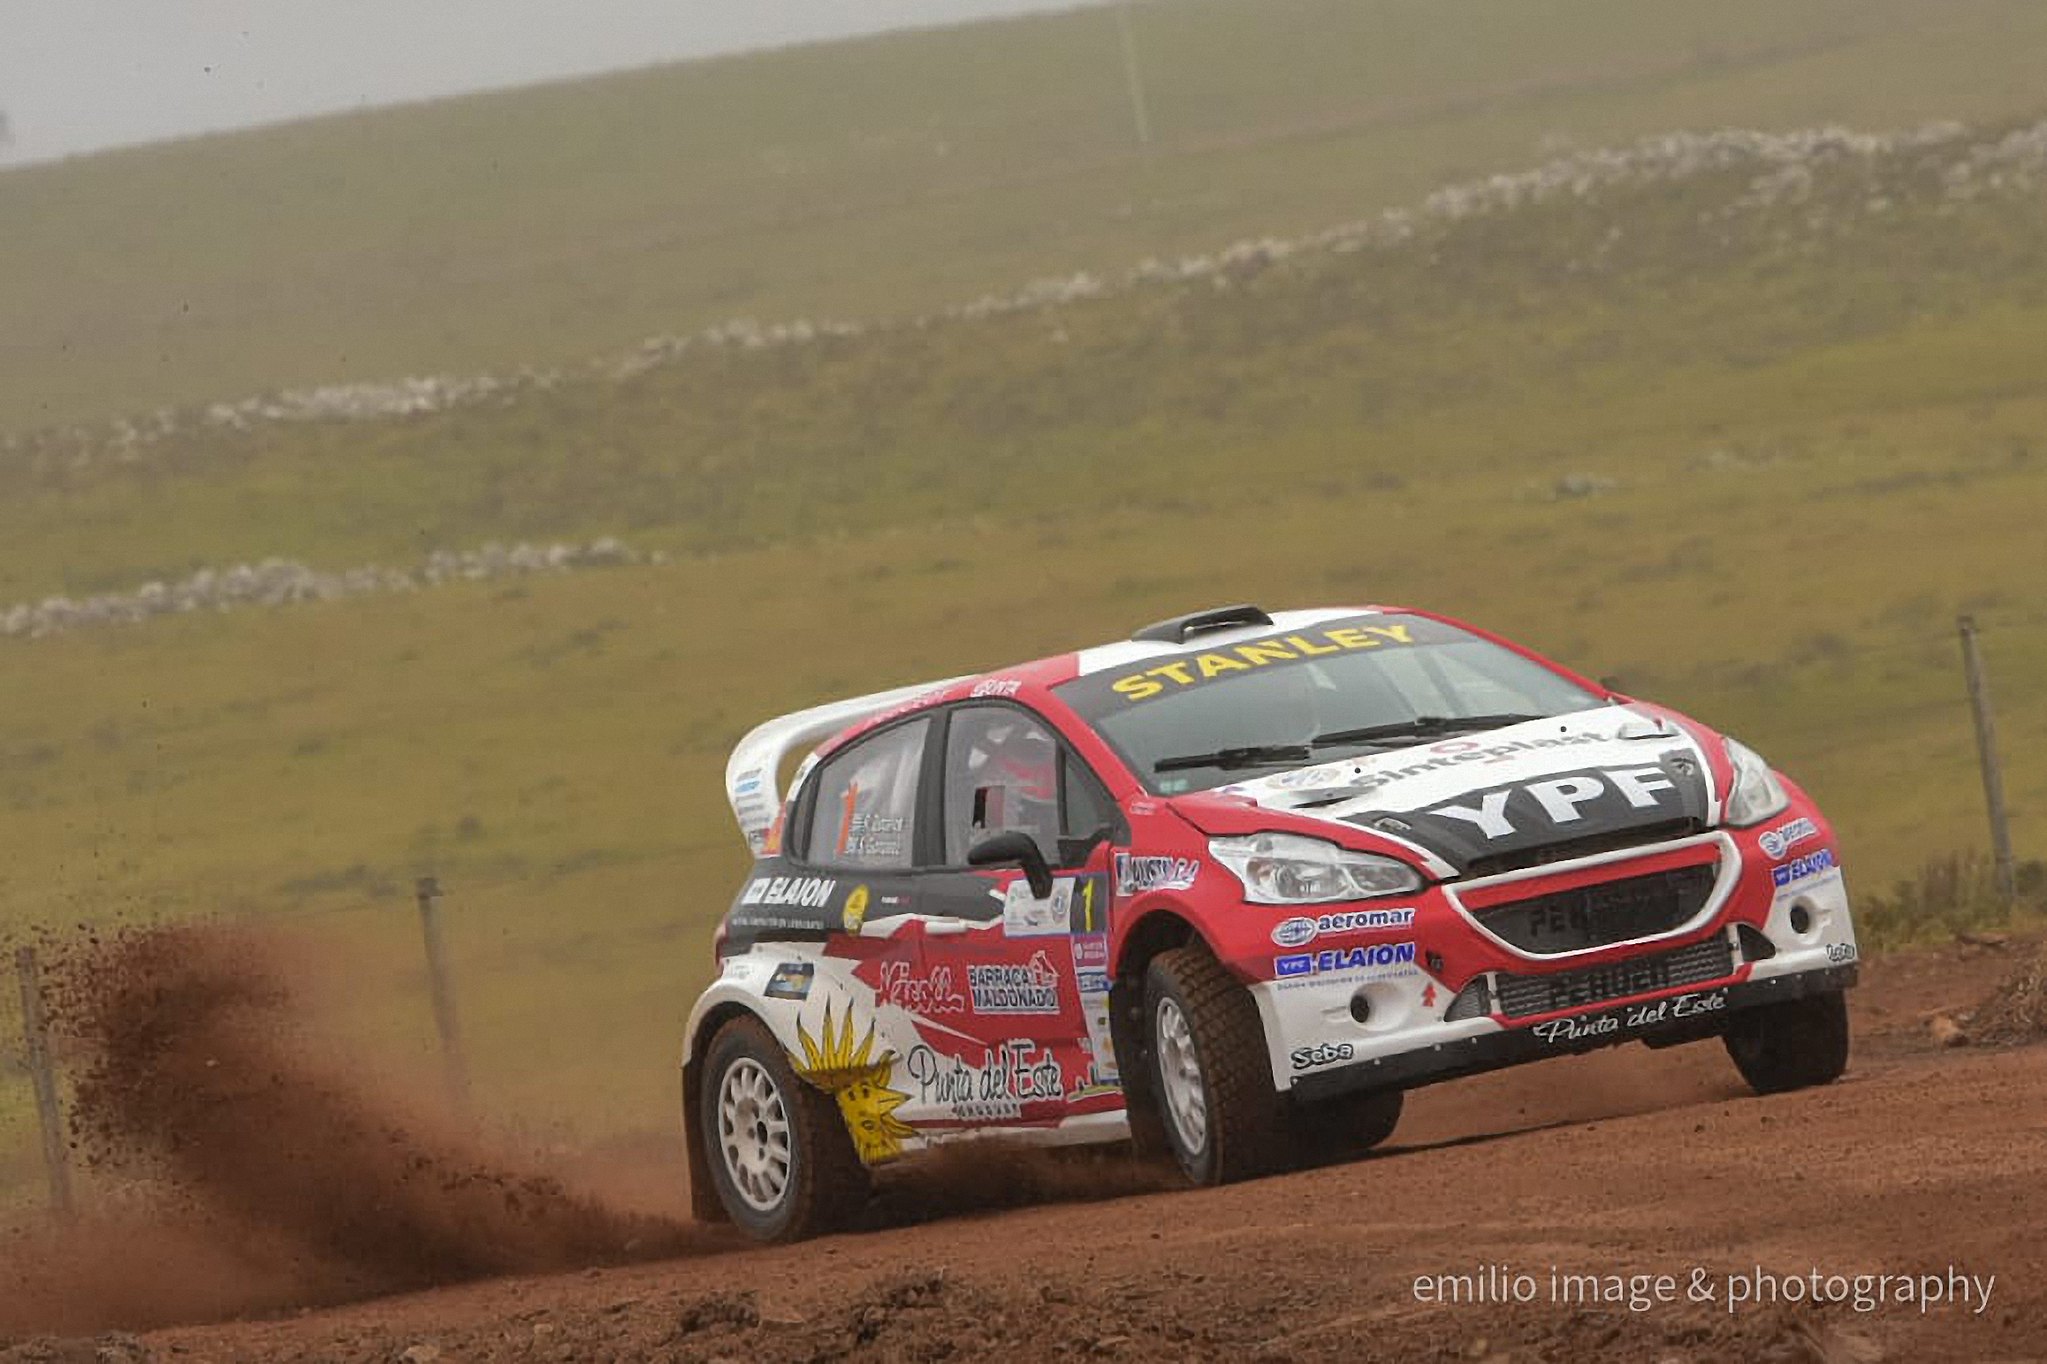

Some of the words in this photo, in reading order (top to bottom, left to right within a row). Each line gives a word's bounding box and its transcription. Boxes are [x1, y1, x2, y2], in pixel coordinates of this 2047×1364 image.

[1112, 624, 1414, 700] STANLEY
[1429, 766, 1676, 840] YPF
[763, 878, 836, 907] ELAION
[1082, 878, 1095, 932] 1
[1318, 909, 1413, 931] aeromar
[1317, 943, 1415, 972] ELAION
[968, 967, 1028, 986] BARRACA
[972, 985, 1055, 1007] MALDONADO
[1532, 1014, 1619, 1043] Punta
[1626, 1001, 1667, 1027] del
[1672, 993, 1726, 1017] Este
[1291, 1043, 1353, 1069] Seba
[907, 1044, 974, 1104] Punta
[979, 1048, 1008, 1101] del
[1010, 1043, 1062, 1098] Este
